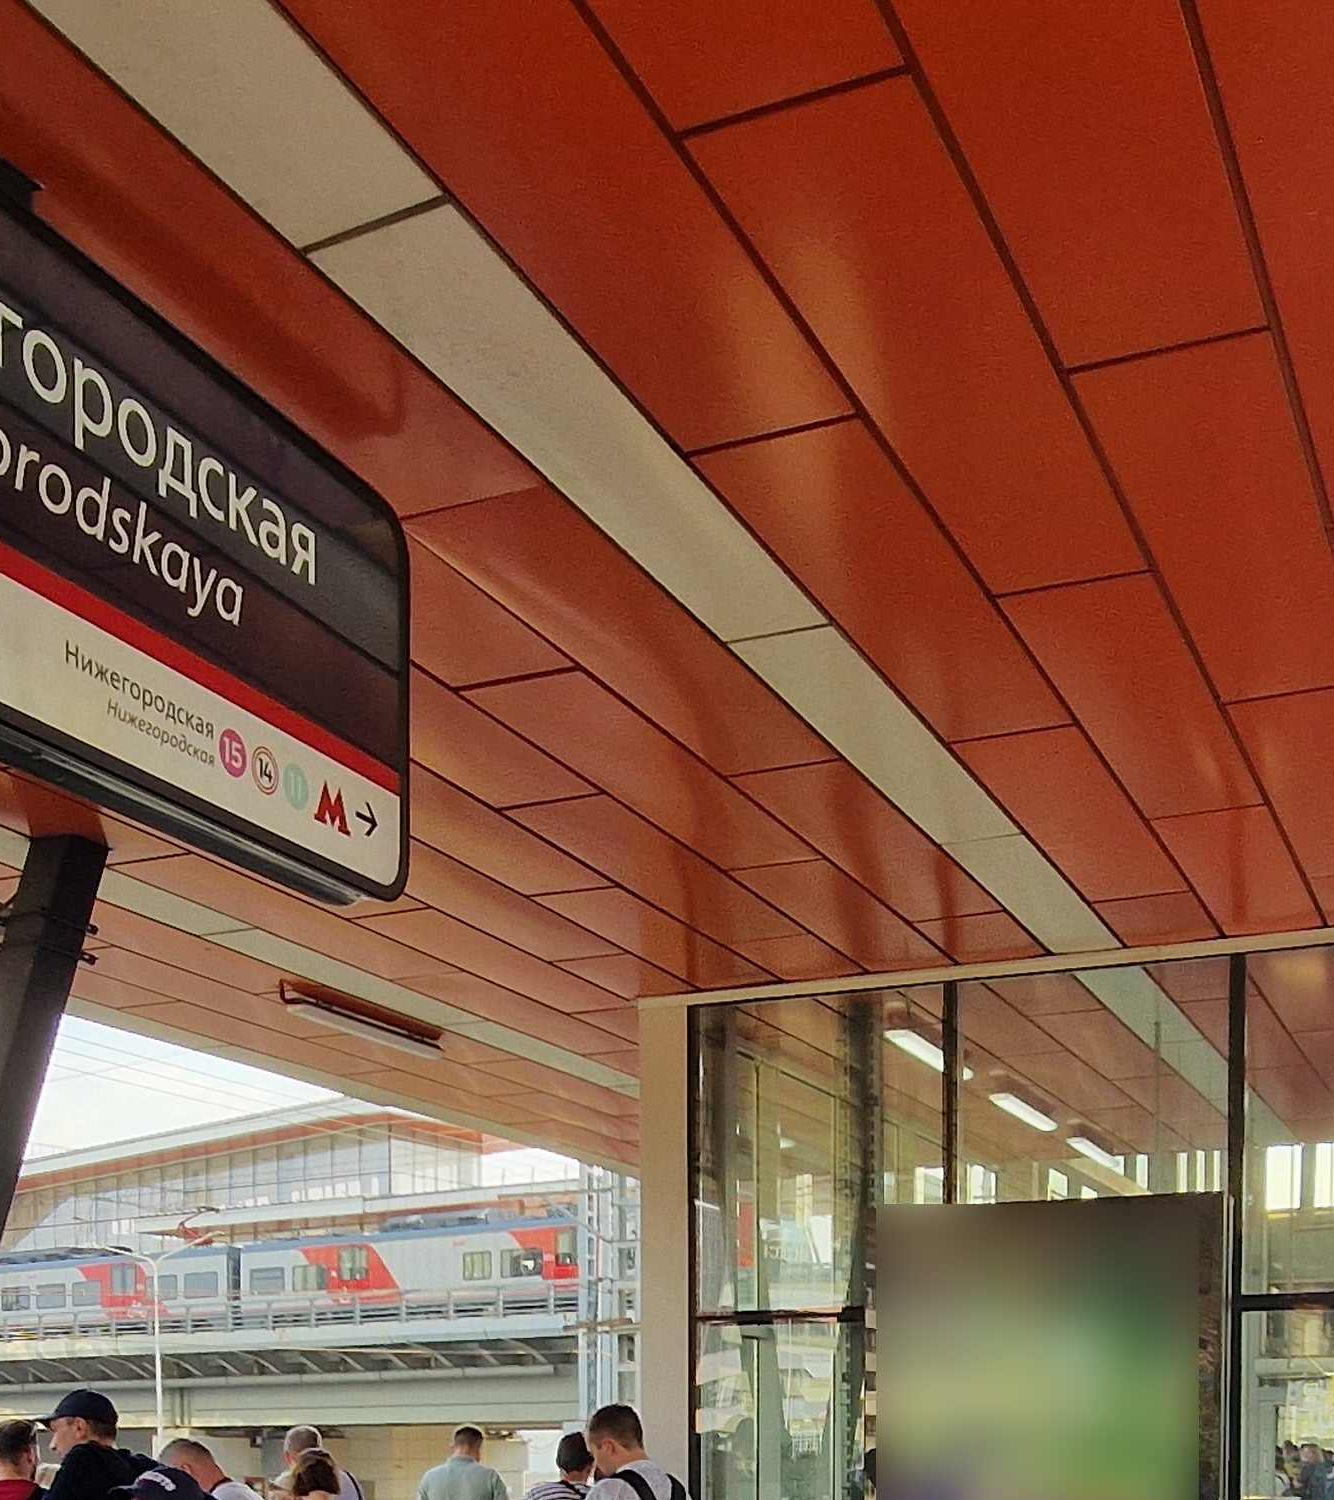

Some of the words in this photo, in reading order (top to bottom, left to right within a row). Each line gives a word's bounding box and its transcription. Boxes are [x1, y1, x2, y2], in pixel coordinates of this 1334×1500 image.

[65, 639, 216, 740] Нижегородская
[107, 697, 216, 768] Нижегородская
[222, 736, 244, 769] 15
